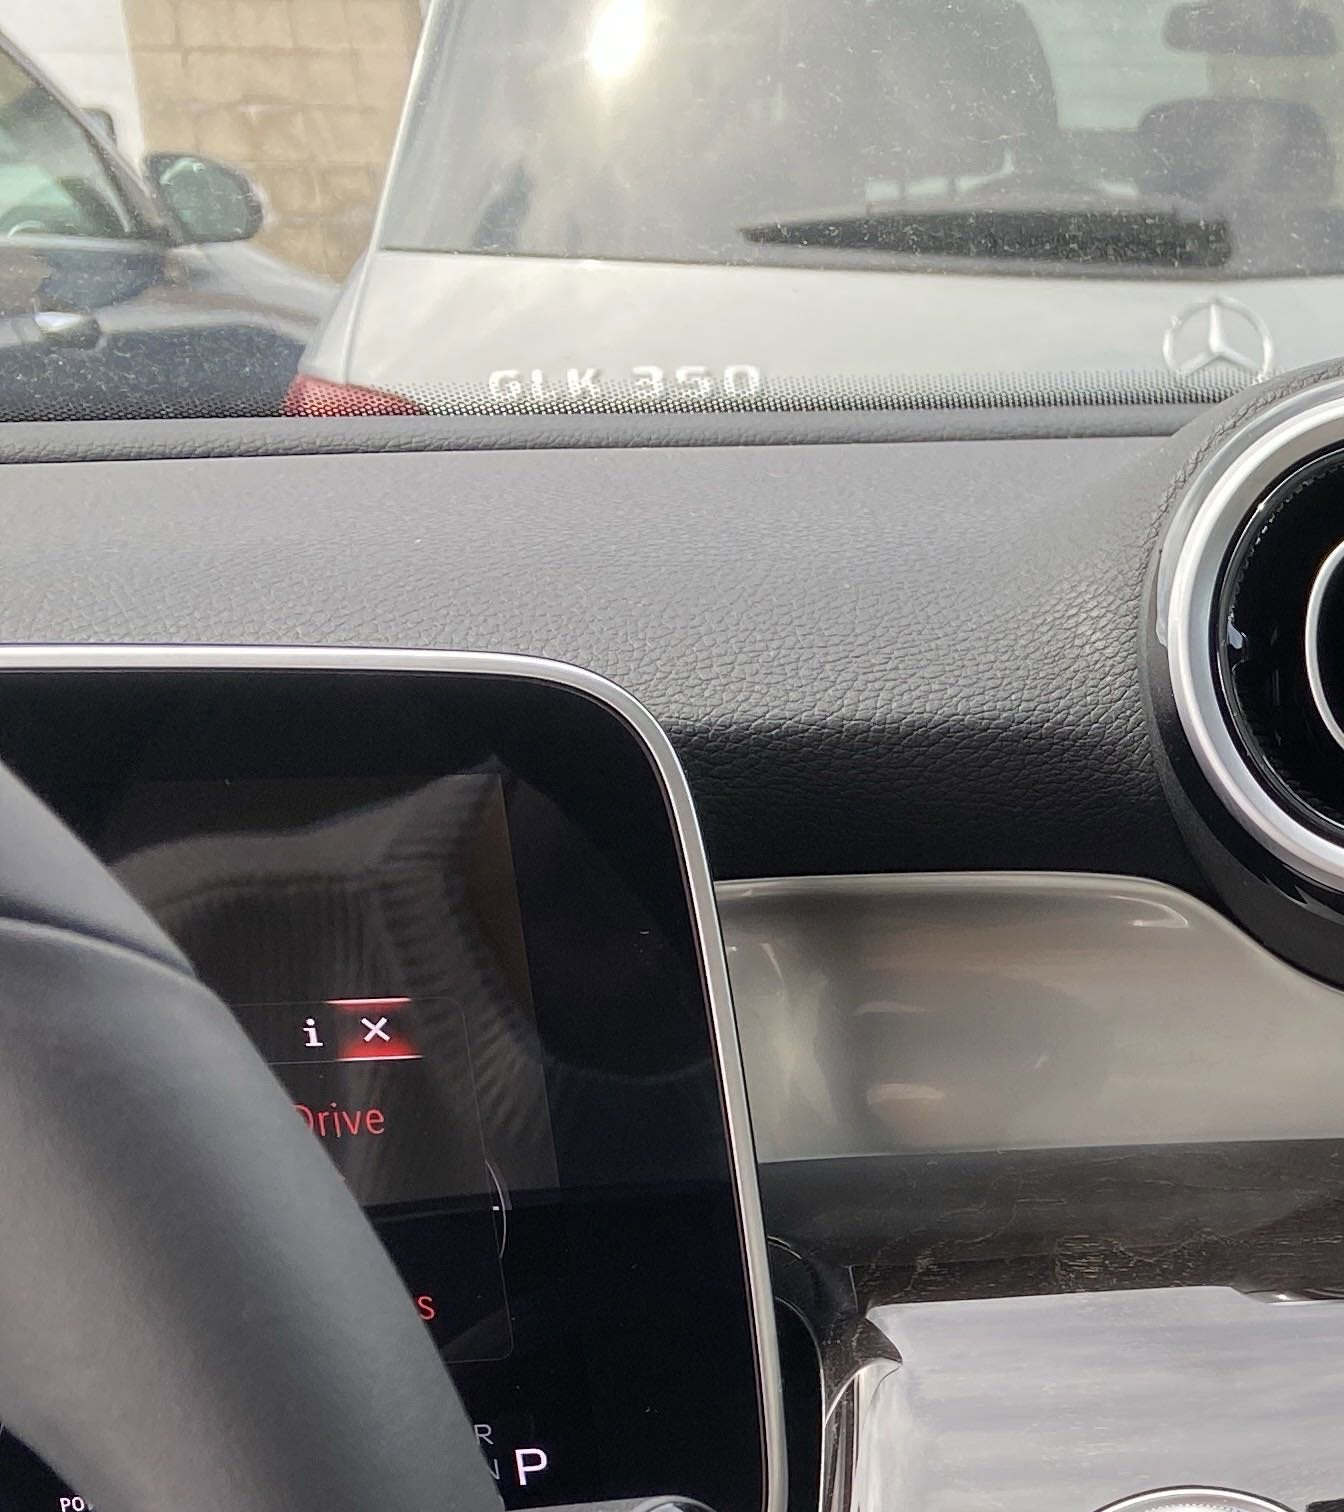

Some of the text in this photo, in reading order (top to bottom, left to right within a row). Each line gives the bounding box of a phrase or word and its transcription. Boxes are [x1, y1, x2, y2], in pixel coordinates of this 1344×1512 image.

[631, 365, 762, 398] 350
[474, 1423, 494, 1445] R
[515, 1448, 547, 1486] P
